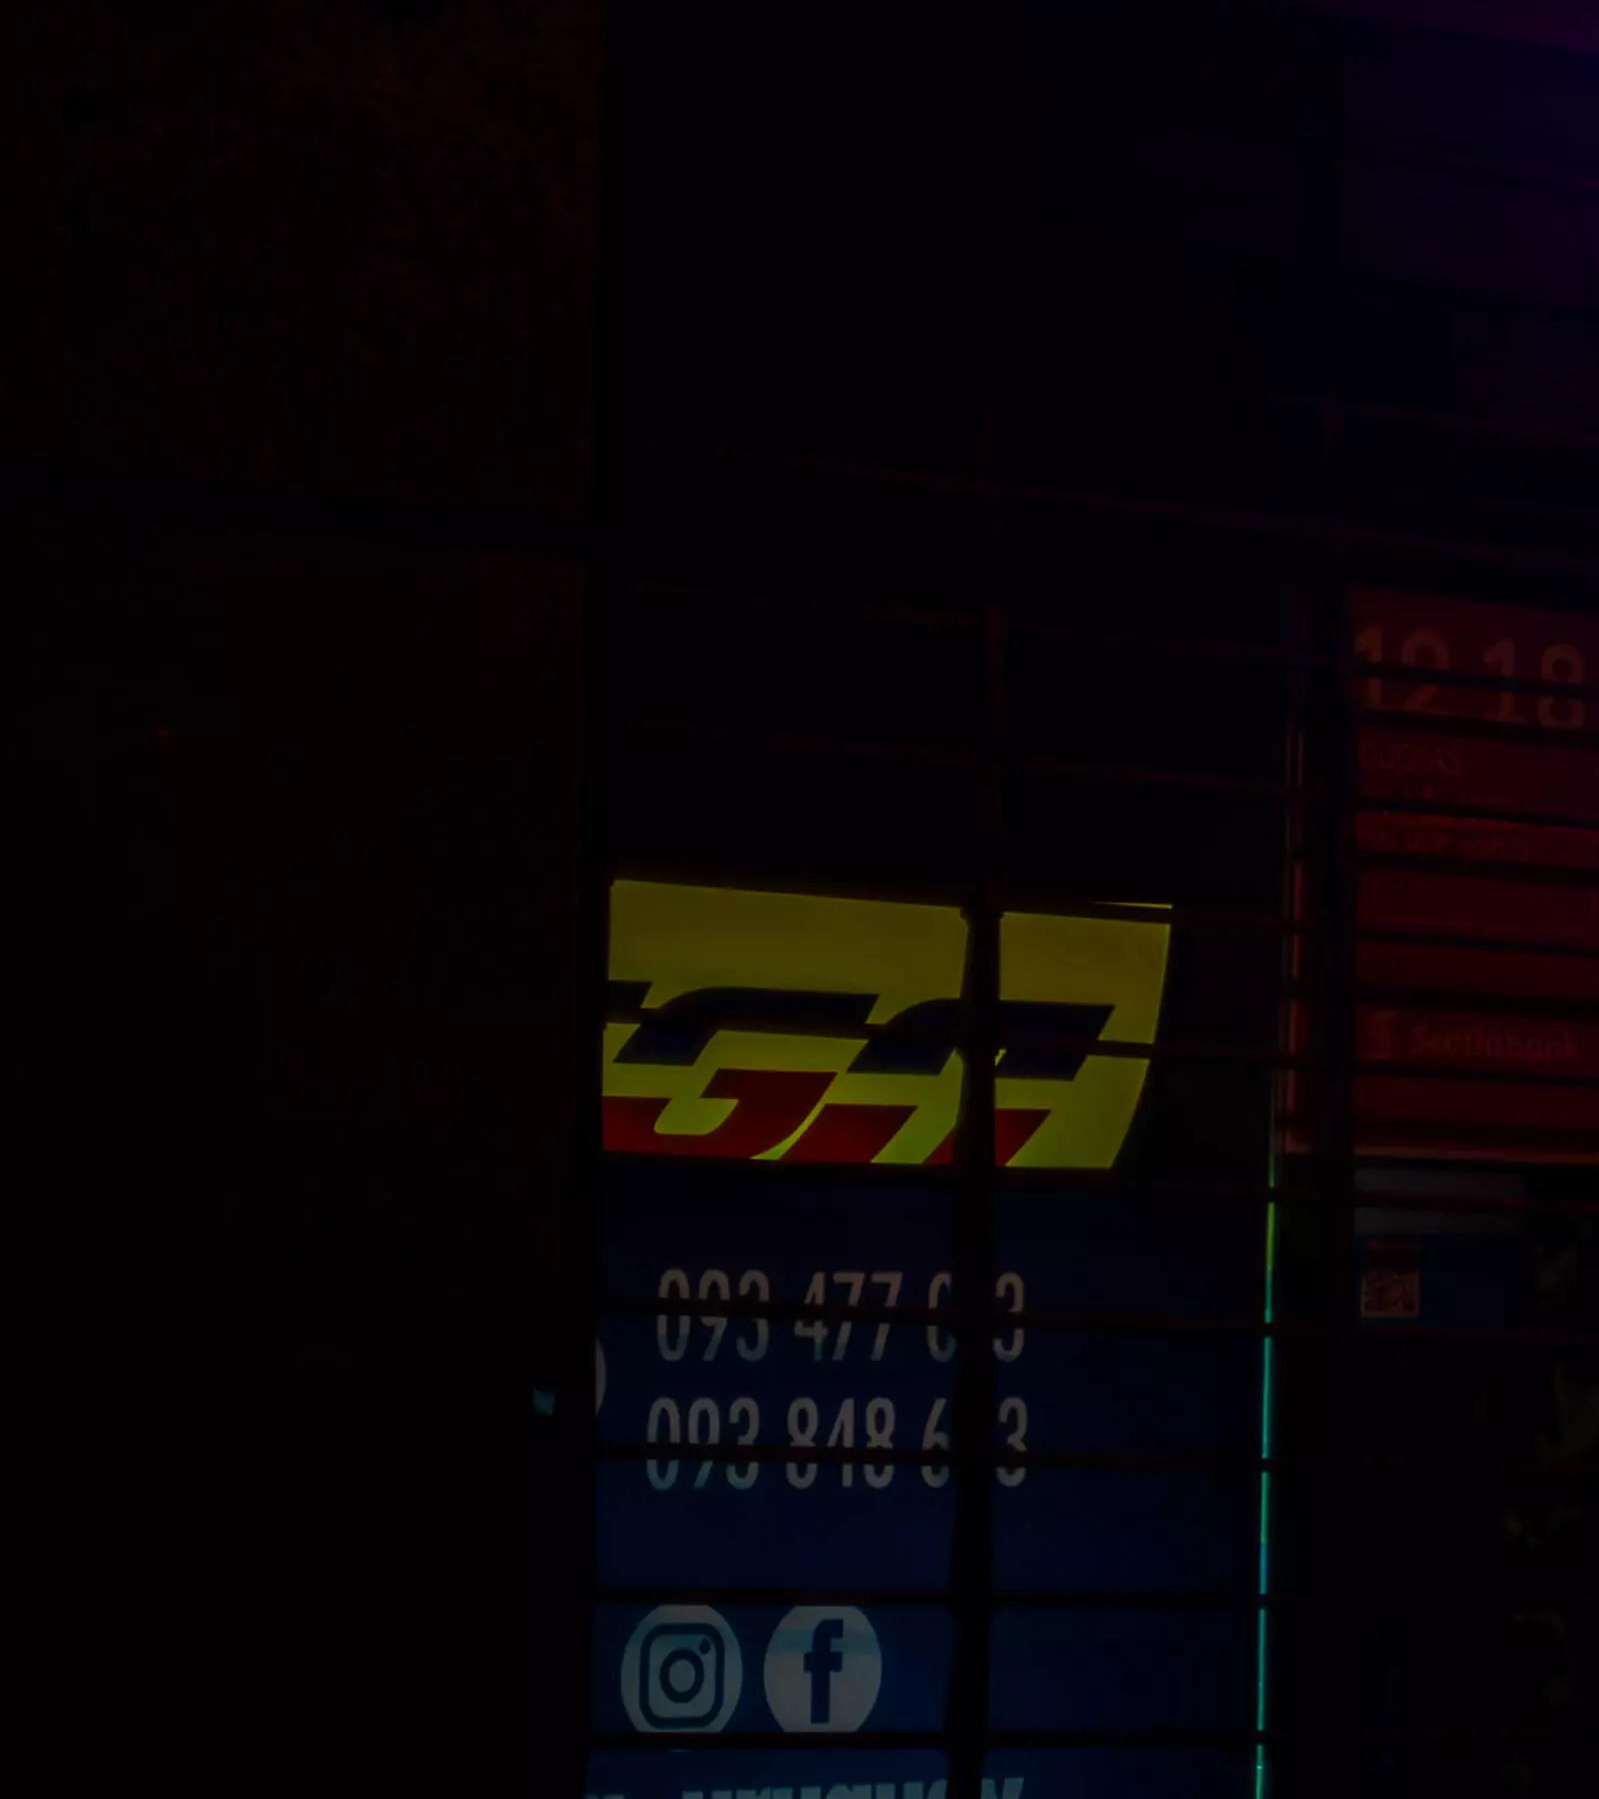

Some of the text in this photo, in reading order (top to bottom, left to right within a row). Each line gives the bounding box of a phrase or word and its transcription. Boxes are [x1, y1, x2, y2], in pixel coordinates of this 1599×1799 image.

[1483, 638, 1586, 730] 18
[656, 1268, 1025, 1362] 093 477 03
[646, 1396, 1028, 1490] 093 848 63
